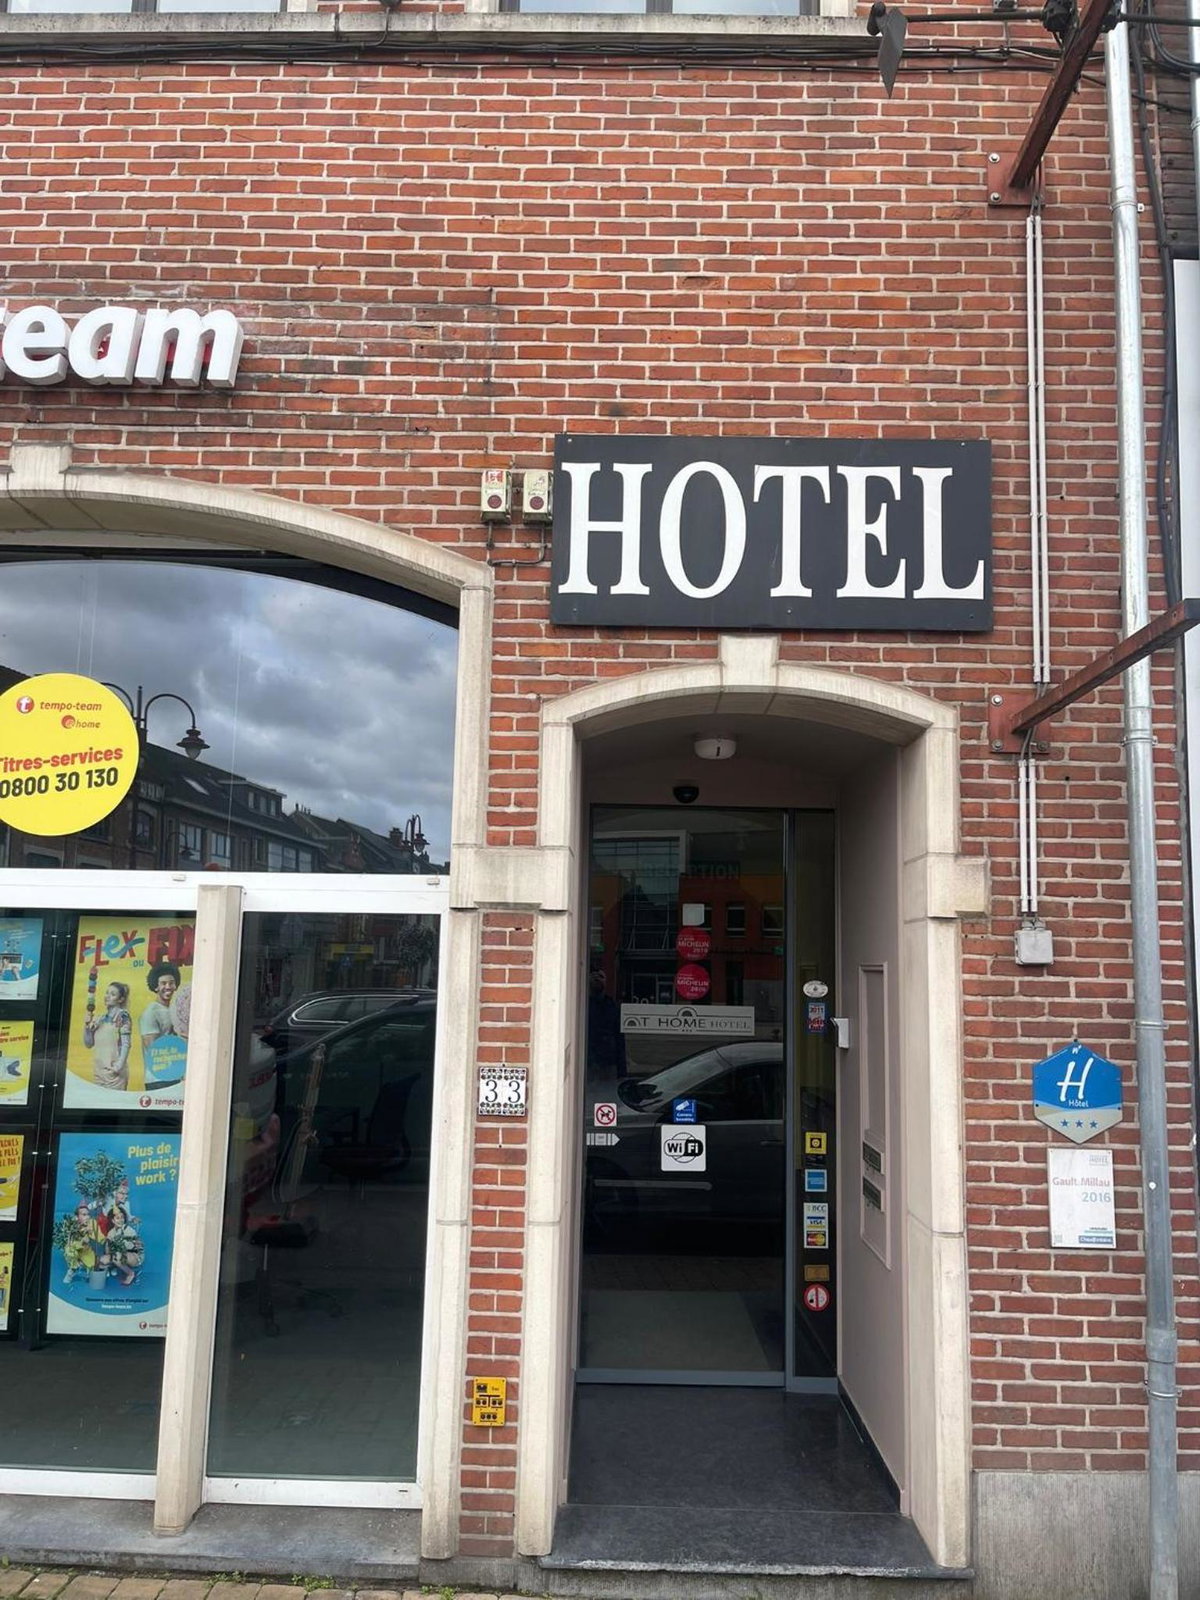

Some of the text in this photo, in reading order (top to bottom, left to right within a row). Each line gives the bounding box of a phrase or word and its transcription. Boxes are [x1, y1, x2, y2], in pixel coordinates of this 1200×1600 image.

[0, 303, 245, 388] eam
[558, 461, 985, 600] HOTEL
[39, 700, 103, 712] tempo-team
[0, 746, 124, 773] itres-services
[0, 766, 119, 799] 0800 30 130
[658, 1017, 706, 1029] HOME
[710, 1020, 751, 1030] HOTEL
[1068, 1098, 1089, 1108] Hôtel
[128, 1142, 172, 1158] Plus de
[140, 1154, 178, 1173] plaisir
[135, 1171, 166, 1185] work
[1052, 1177, 1111, 1187] Gault Millau
[1081, 1191, 1112, 1203] 2016
